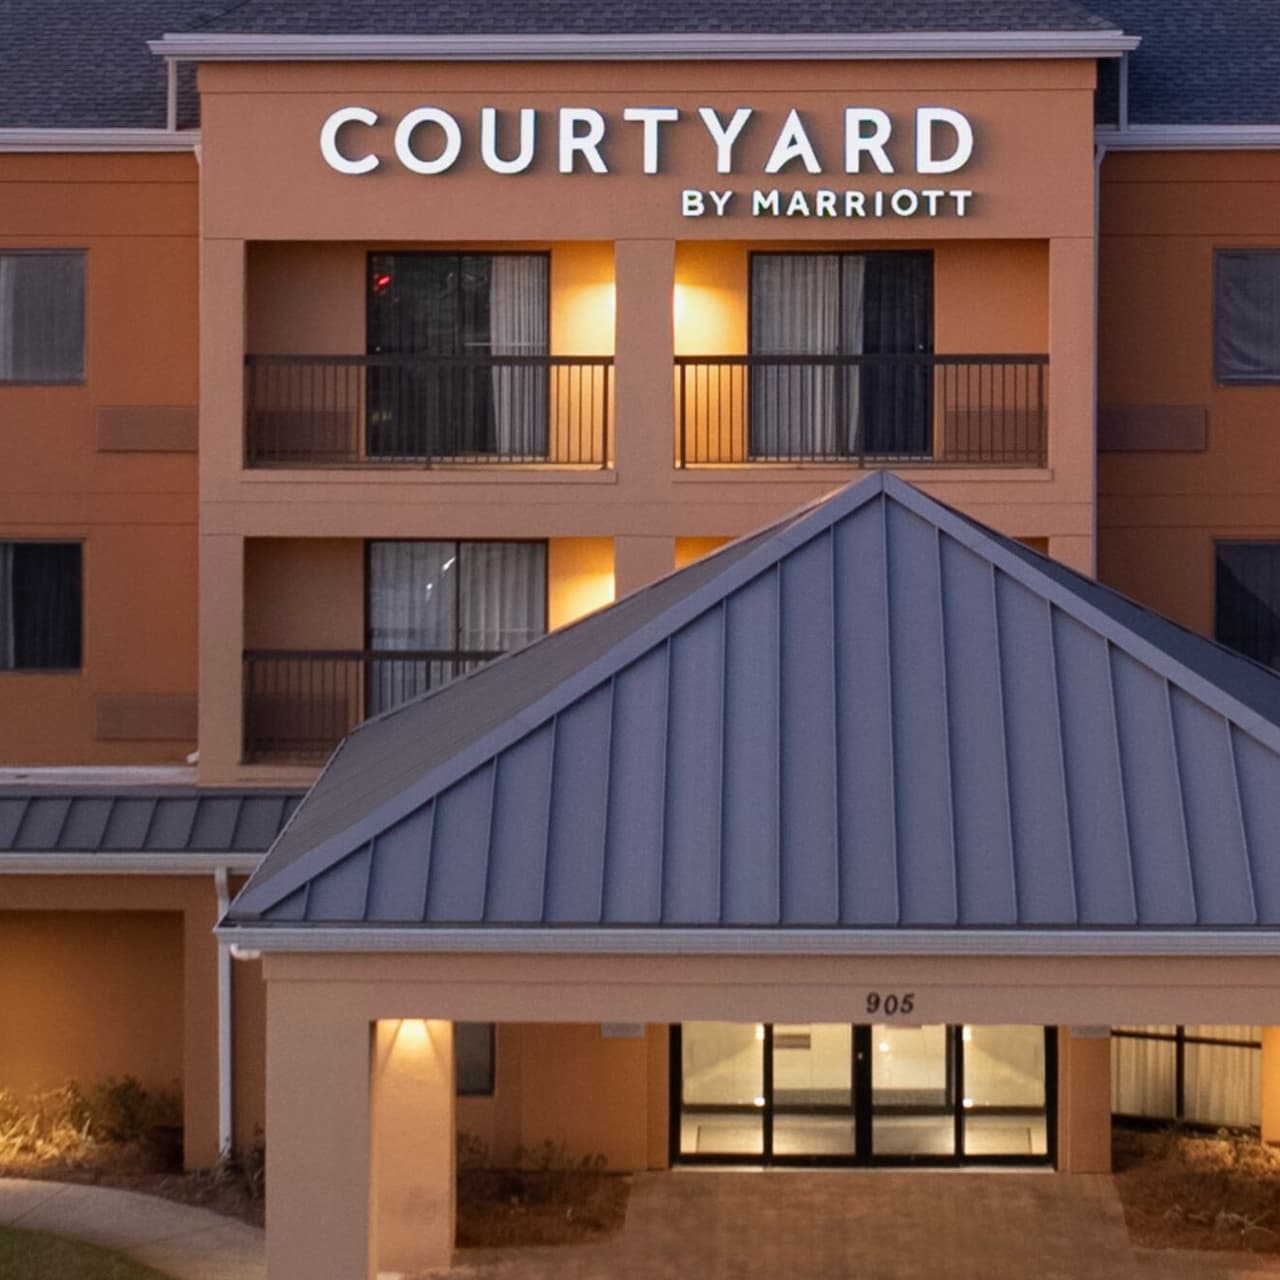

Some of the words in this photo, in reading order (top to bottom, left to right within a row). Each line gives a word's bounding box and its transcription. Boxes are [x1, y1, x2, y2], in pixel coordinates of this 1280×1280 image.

[319, 106, 974, 175] COURTYARD
[681, 189, 734, 218] BY
[751, 188, 973, 218] MARRIOTT
[866, 991, 915, 1016] 905
